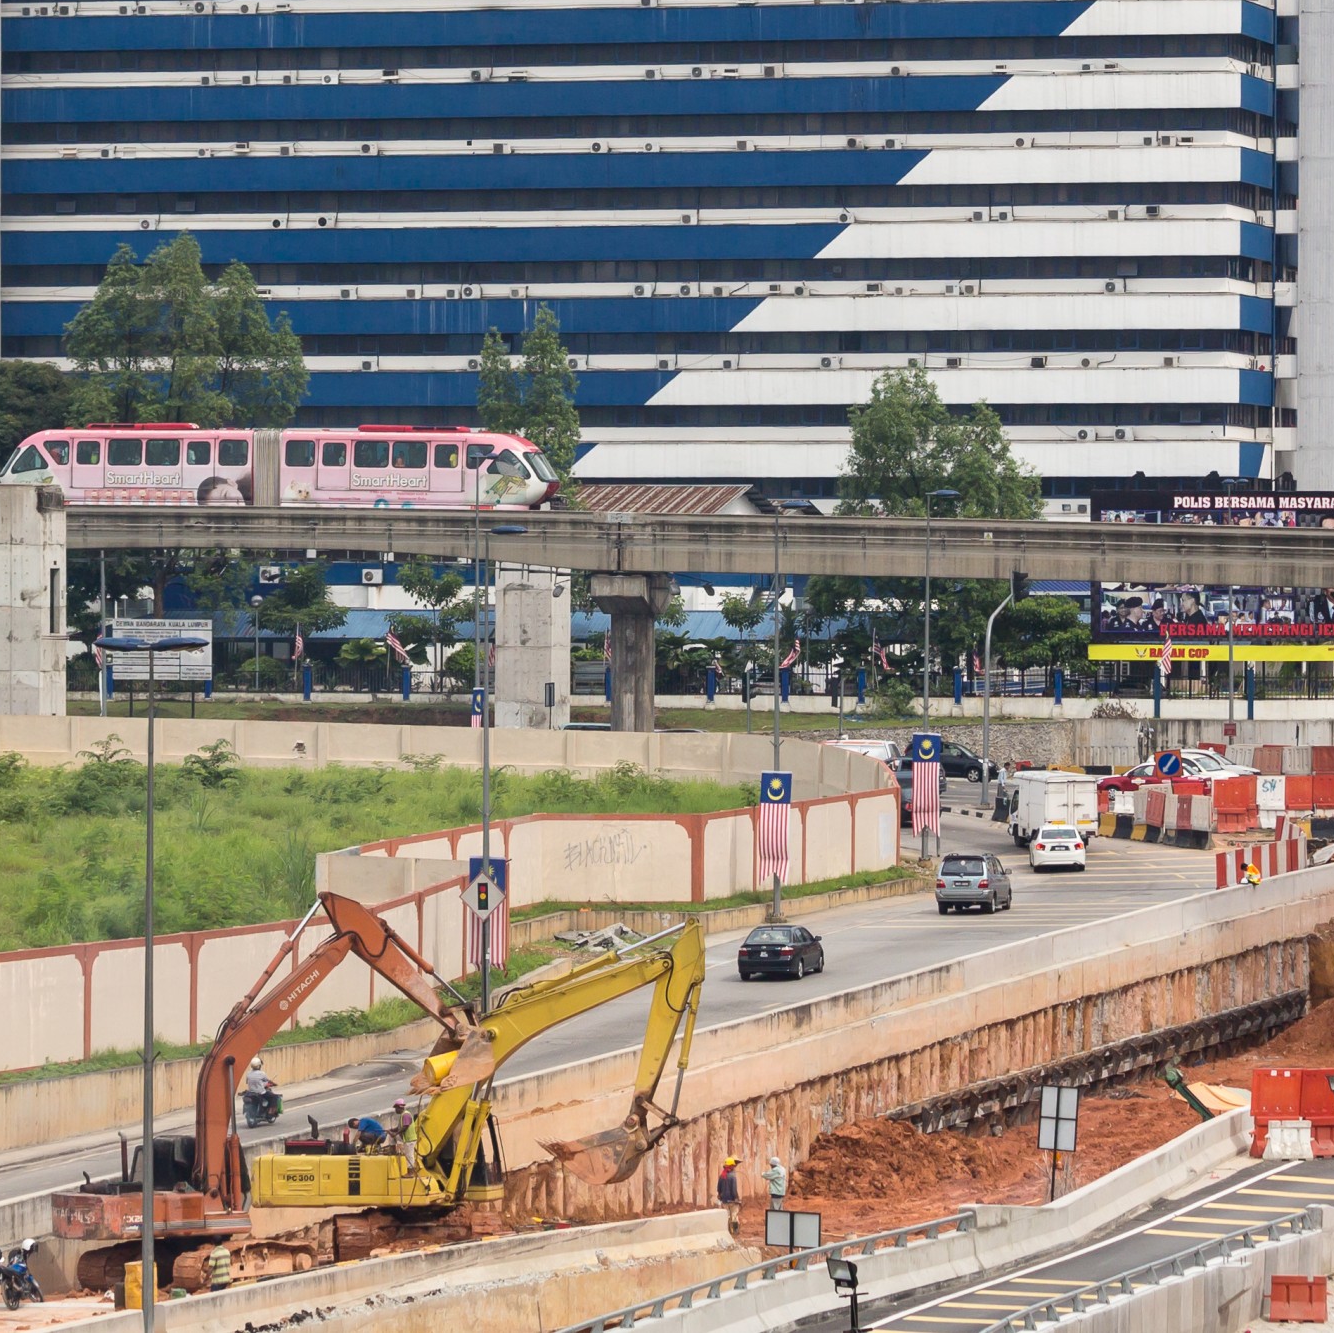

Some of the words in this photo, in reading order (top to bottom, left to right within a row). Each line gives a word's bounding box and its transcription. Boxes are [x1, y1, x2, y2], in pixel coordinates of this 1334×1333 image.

[107, 471, 181, 486] SmartHeart
[352, 473, 428, 488] SmartHeart
[1174, 496, 1211, 509] POLIS
[1214, 496, 1276, 509] BERSAMA
[1160, 624, 1226, 636] BERSAMA
[1232, 624, 1314, 636] MEMERANGI
[1149, 648, 1185, 658] RAAN
[1188, 648, 1209, 658] COP
[287, 969, 320, 1002] HITACHI
[299, 1174, 315, 1182] 300
